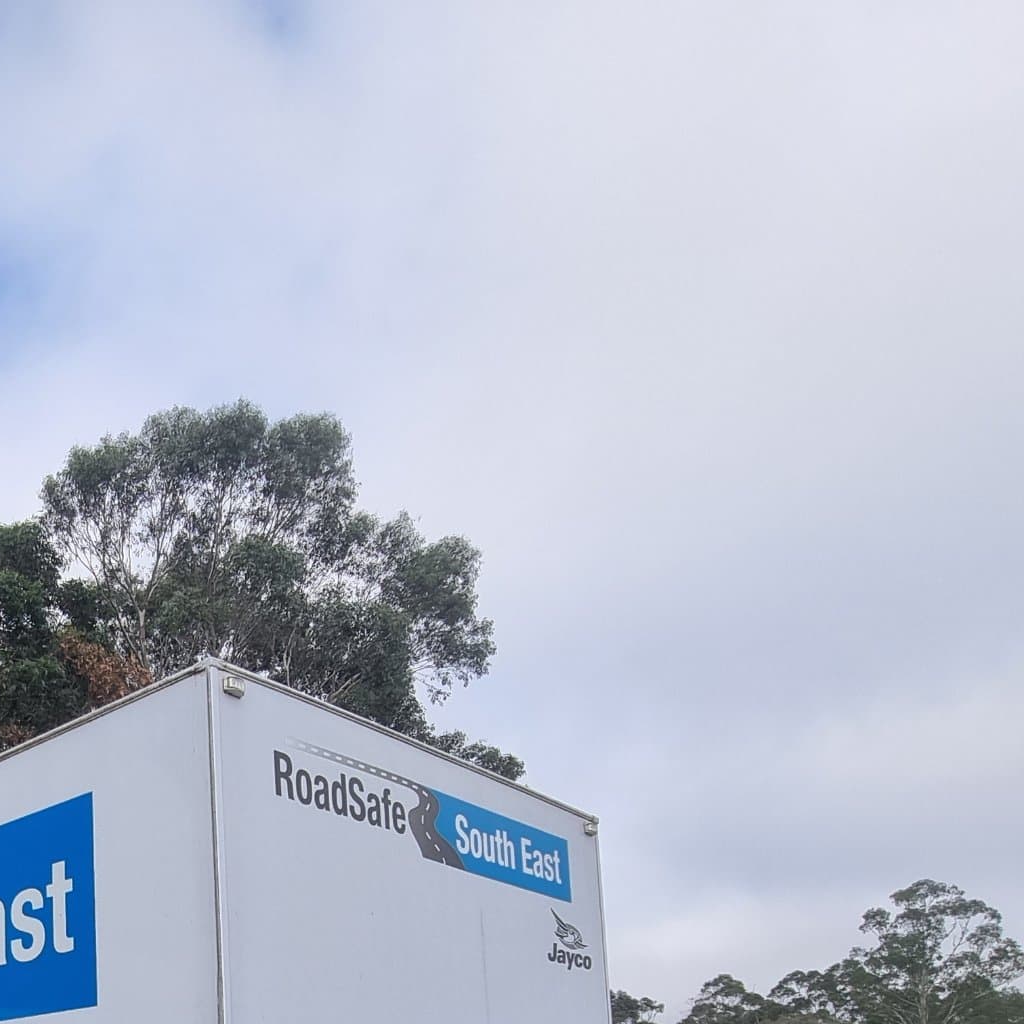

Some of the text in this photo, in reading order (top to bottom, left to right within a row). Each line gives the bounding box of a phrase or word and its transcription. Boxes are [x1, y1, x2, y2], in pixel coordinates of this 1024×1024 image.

[273, 749, 563, 885] RoadSafe South East
[547, 942, 592, 971] Jayco
